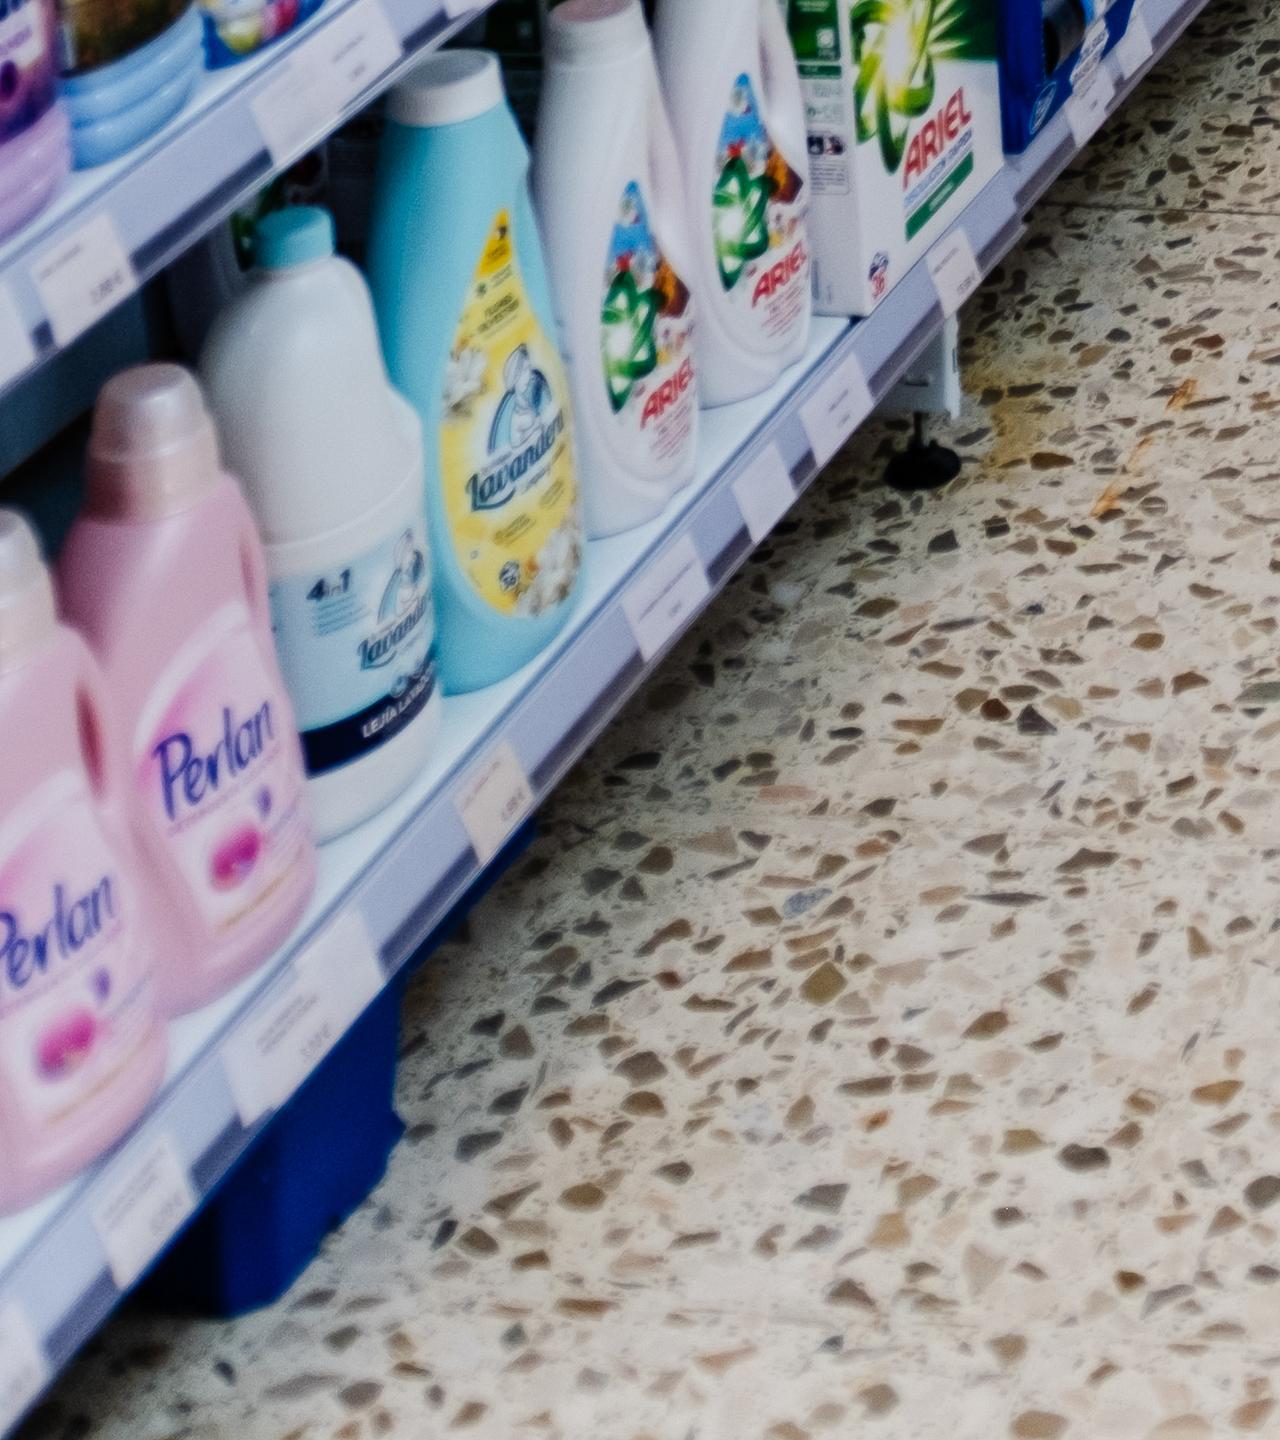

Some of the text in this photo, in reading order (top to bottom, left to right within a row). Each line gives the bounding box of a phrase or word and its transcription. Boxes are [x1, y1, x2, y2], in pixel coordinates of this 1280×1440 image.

[902, 85, 974, 191] ARIEL
[151, 690, 279, 823] Perlan
[0, 872, 118, 994] Perlan
